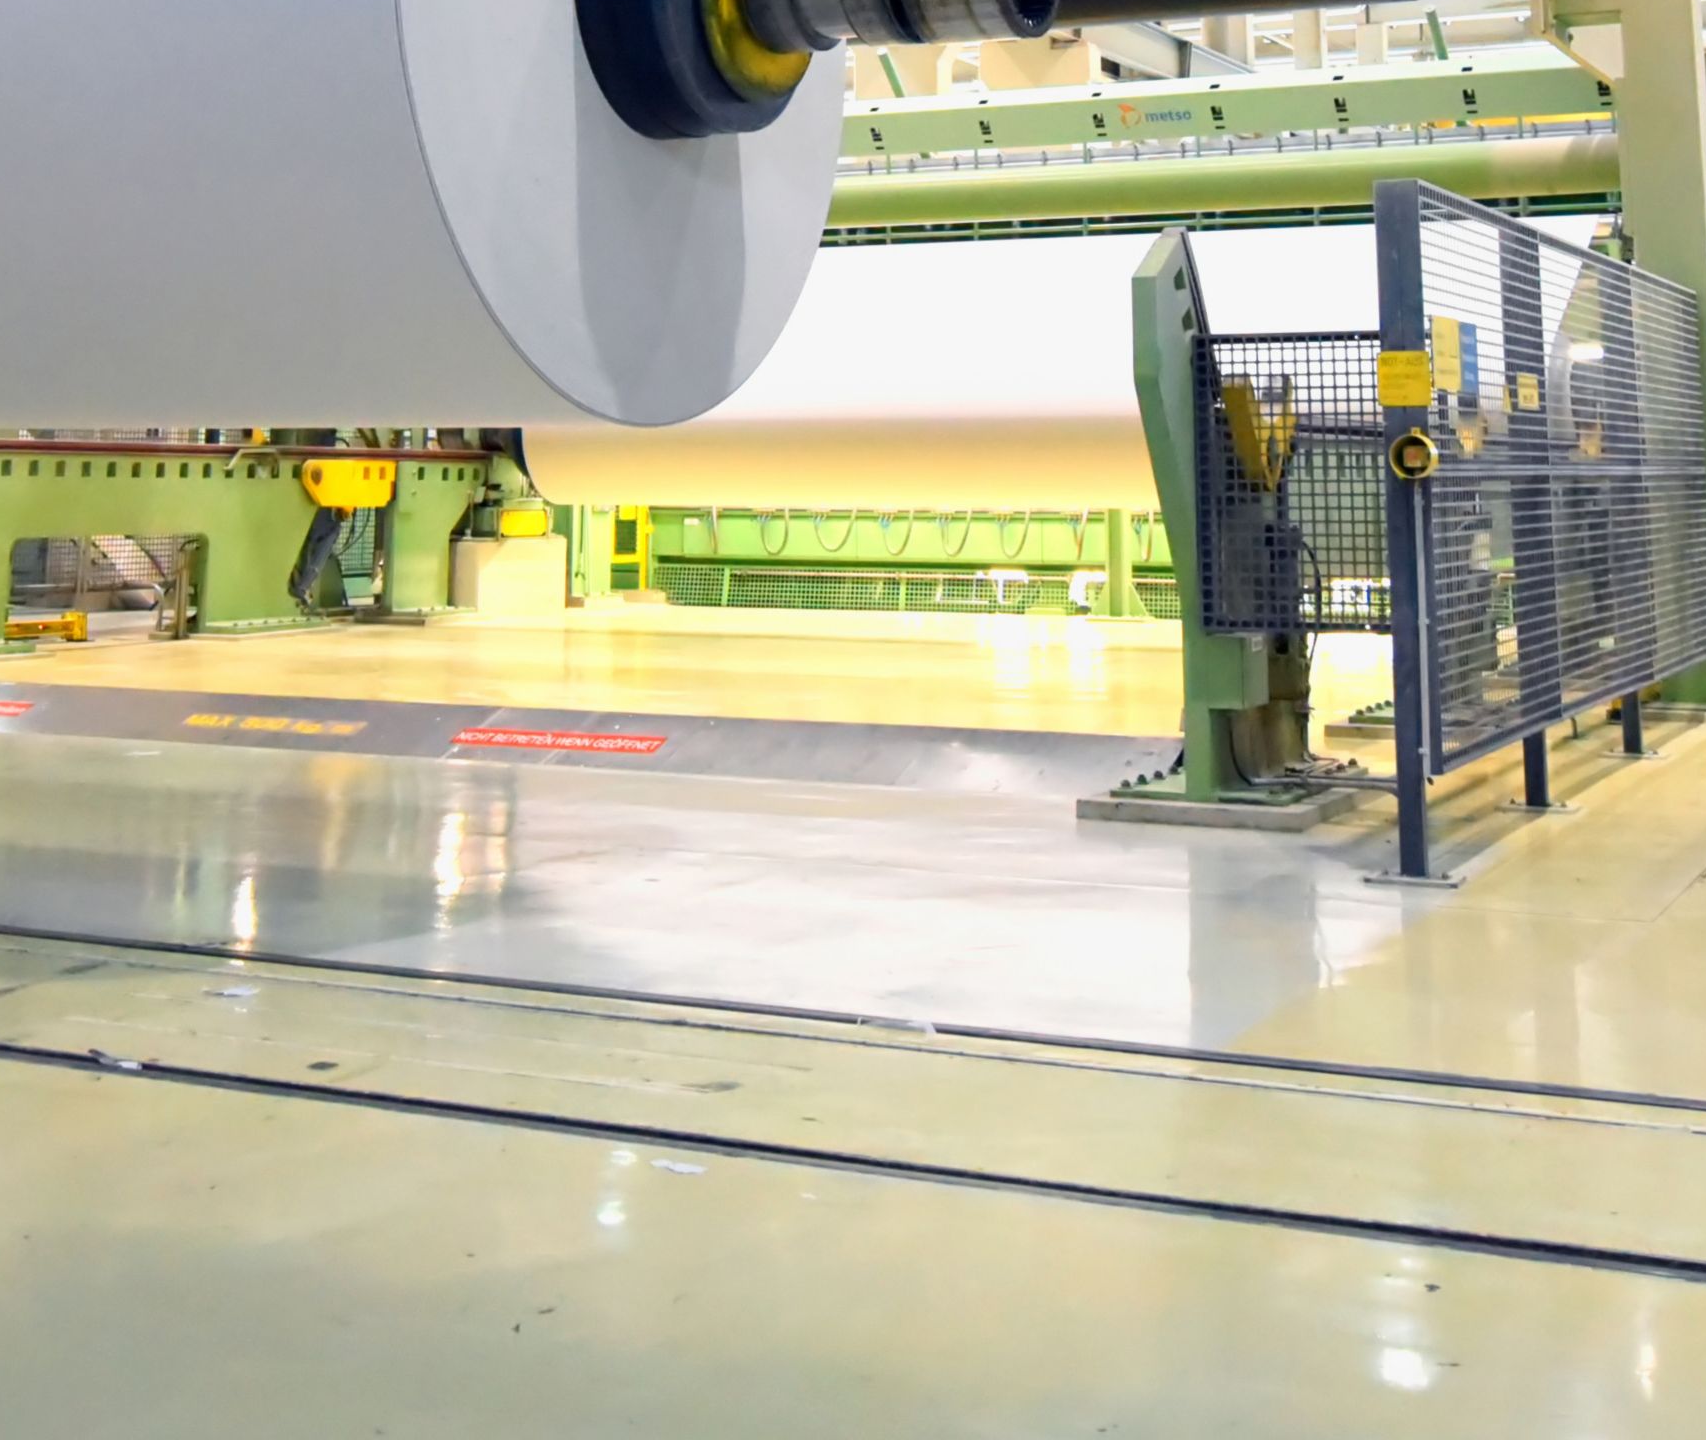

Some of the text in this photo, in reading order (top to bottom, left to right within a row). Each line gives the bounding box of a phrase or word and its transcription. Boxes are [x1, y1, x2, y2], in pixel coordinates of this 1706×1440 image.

[1144, 110, 1192, 123] metso
[456, 731, 494, 741] NICHT
[492, 733, 555, 745] BETRETEN
[554, 736, 593, 747] WENN
